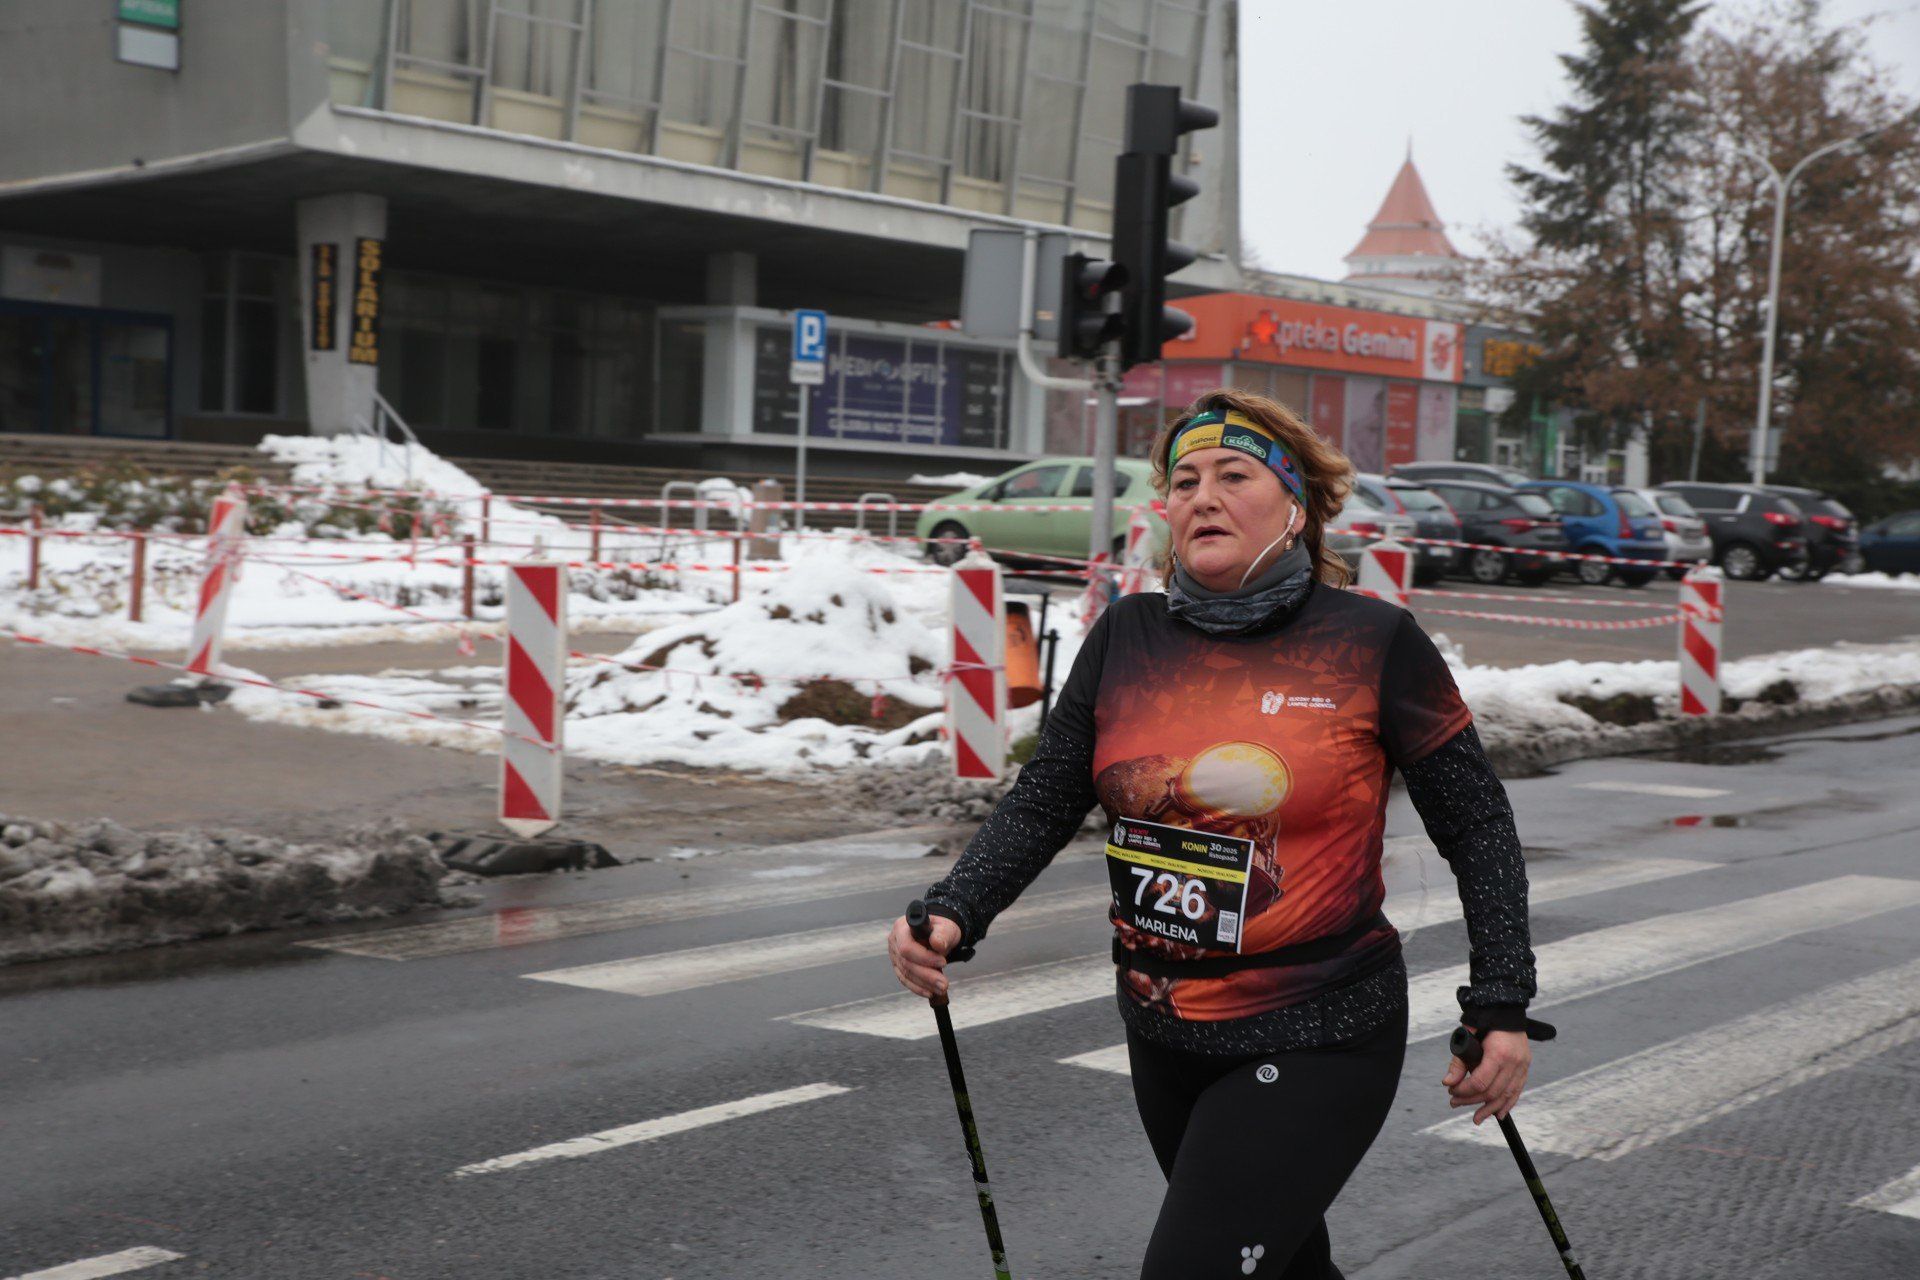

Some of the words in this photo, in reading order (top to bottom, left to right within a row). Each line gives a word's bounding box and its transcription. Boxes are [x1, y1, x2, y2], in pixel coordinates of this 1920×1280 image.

[351, 240, 381, 363] SOLARIUM
[801, 316, 821, 356] P
[1343, 322, 1417, 362] Gemini
[1229, 438, 1263, 456] KUPIEC
[1181, 840, 1208, 853] KONIN
[1210, 842, 1222, 852] 30
[1208, 851, 1238, 862] listopada
[1131, 866, 1207, 920] 726
[1135, 914, 1199, 943] MARLENA
